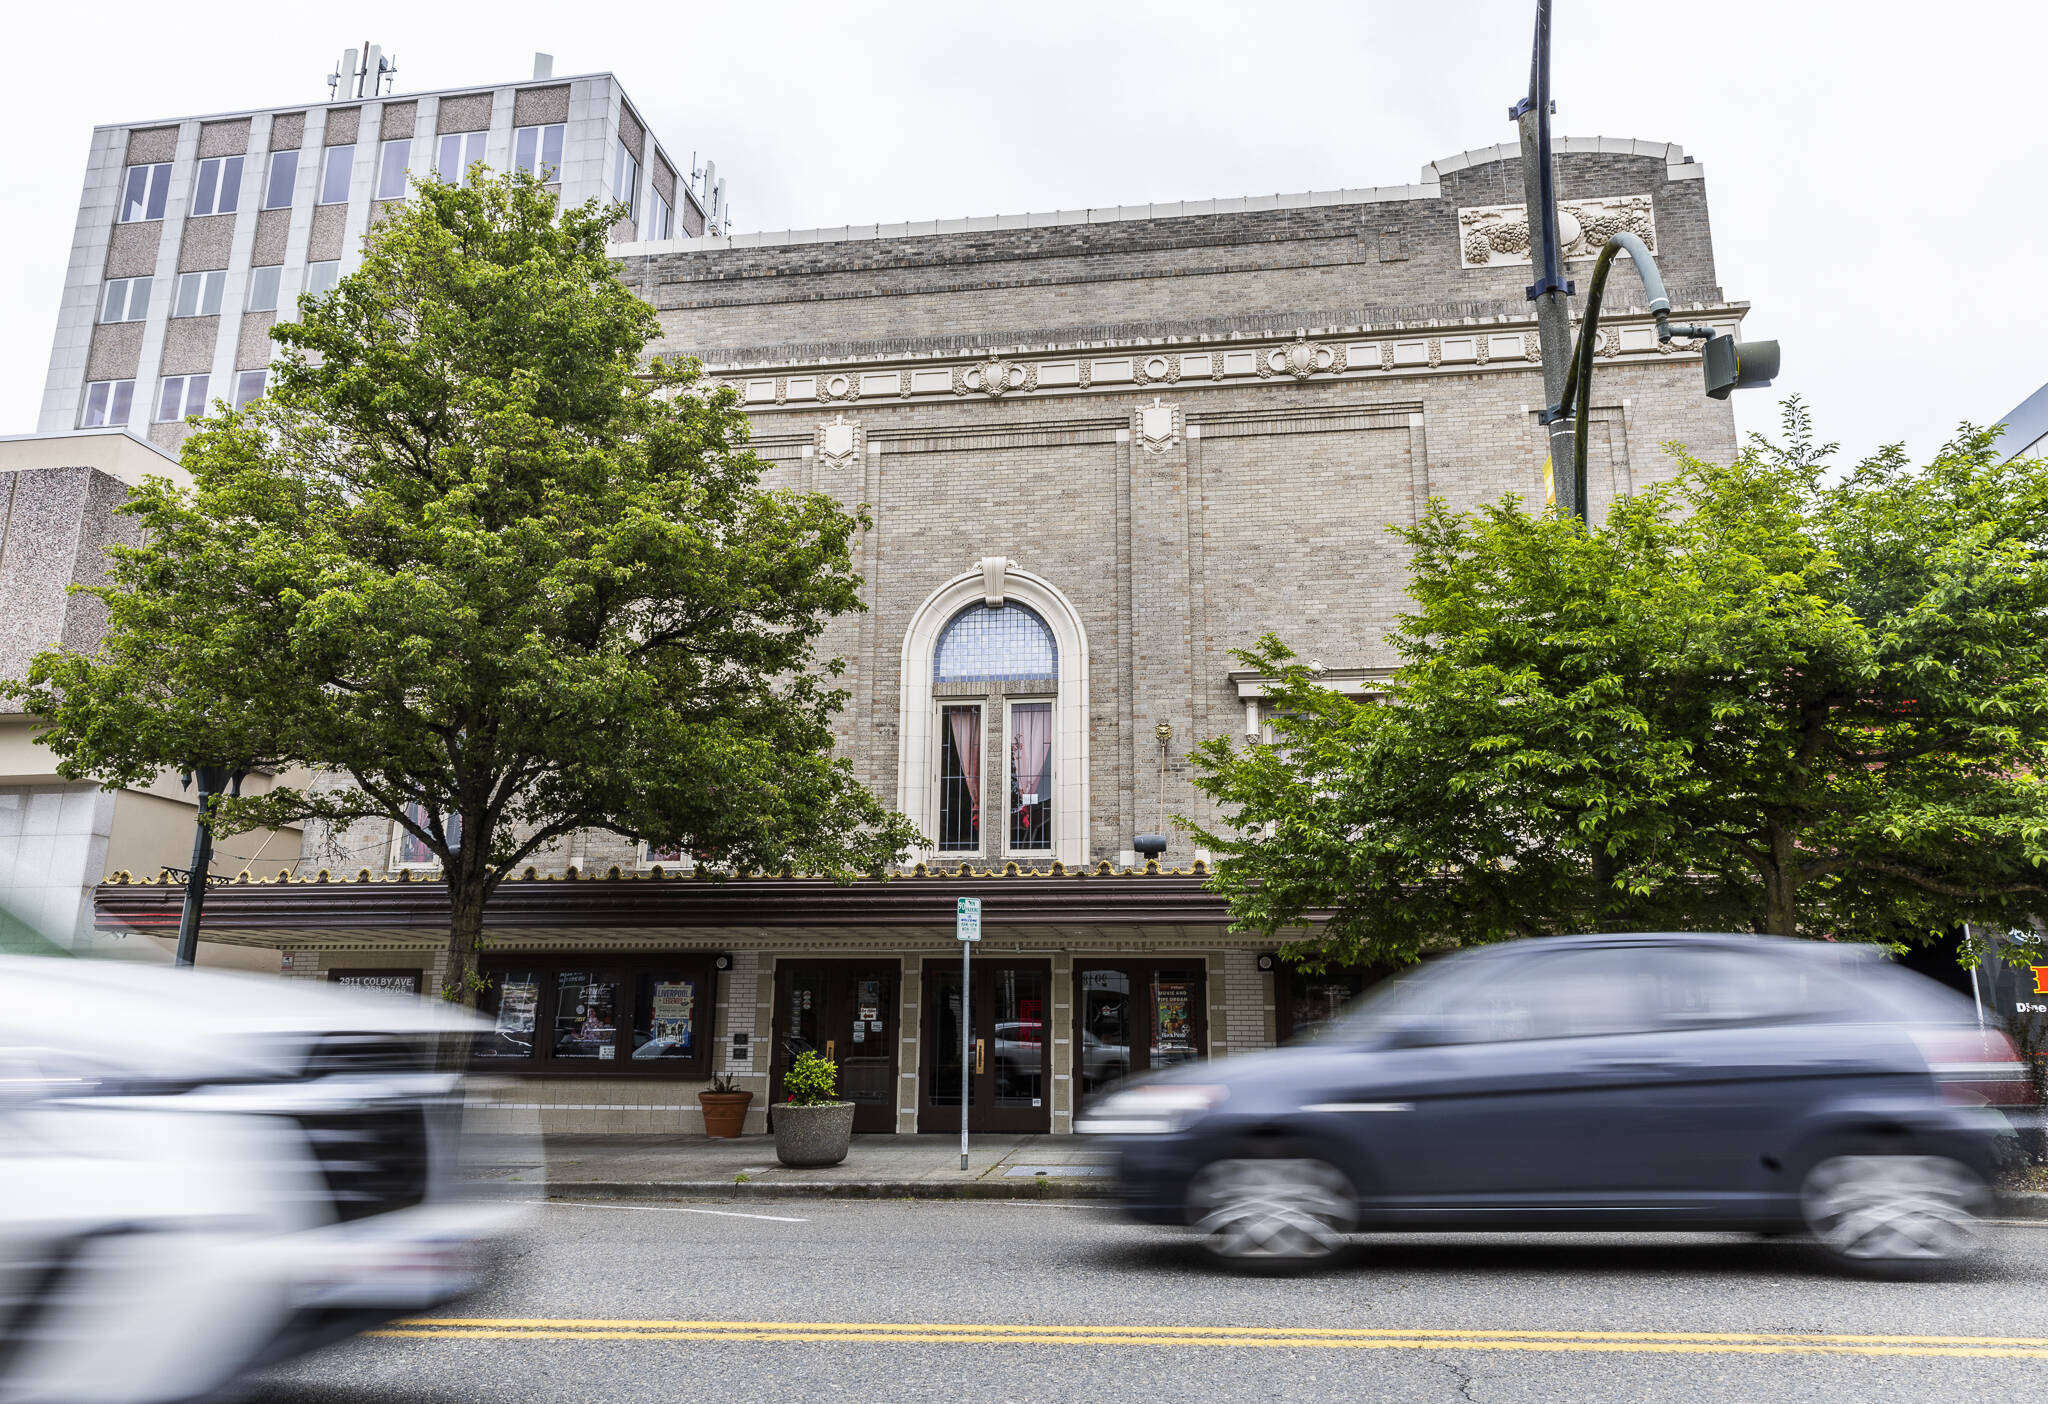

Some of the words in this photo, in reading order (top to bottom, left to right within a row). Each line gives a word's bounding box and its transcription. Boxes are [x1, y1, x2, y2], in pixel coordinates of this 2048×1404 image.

[340, 977, 360, 986] 2911
[363, 977, 392, 986] COLBY
[394, 977, 414, 986] AVE.
[658, 989, 689, 998] LIVERPOOL
